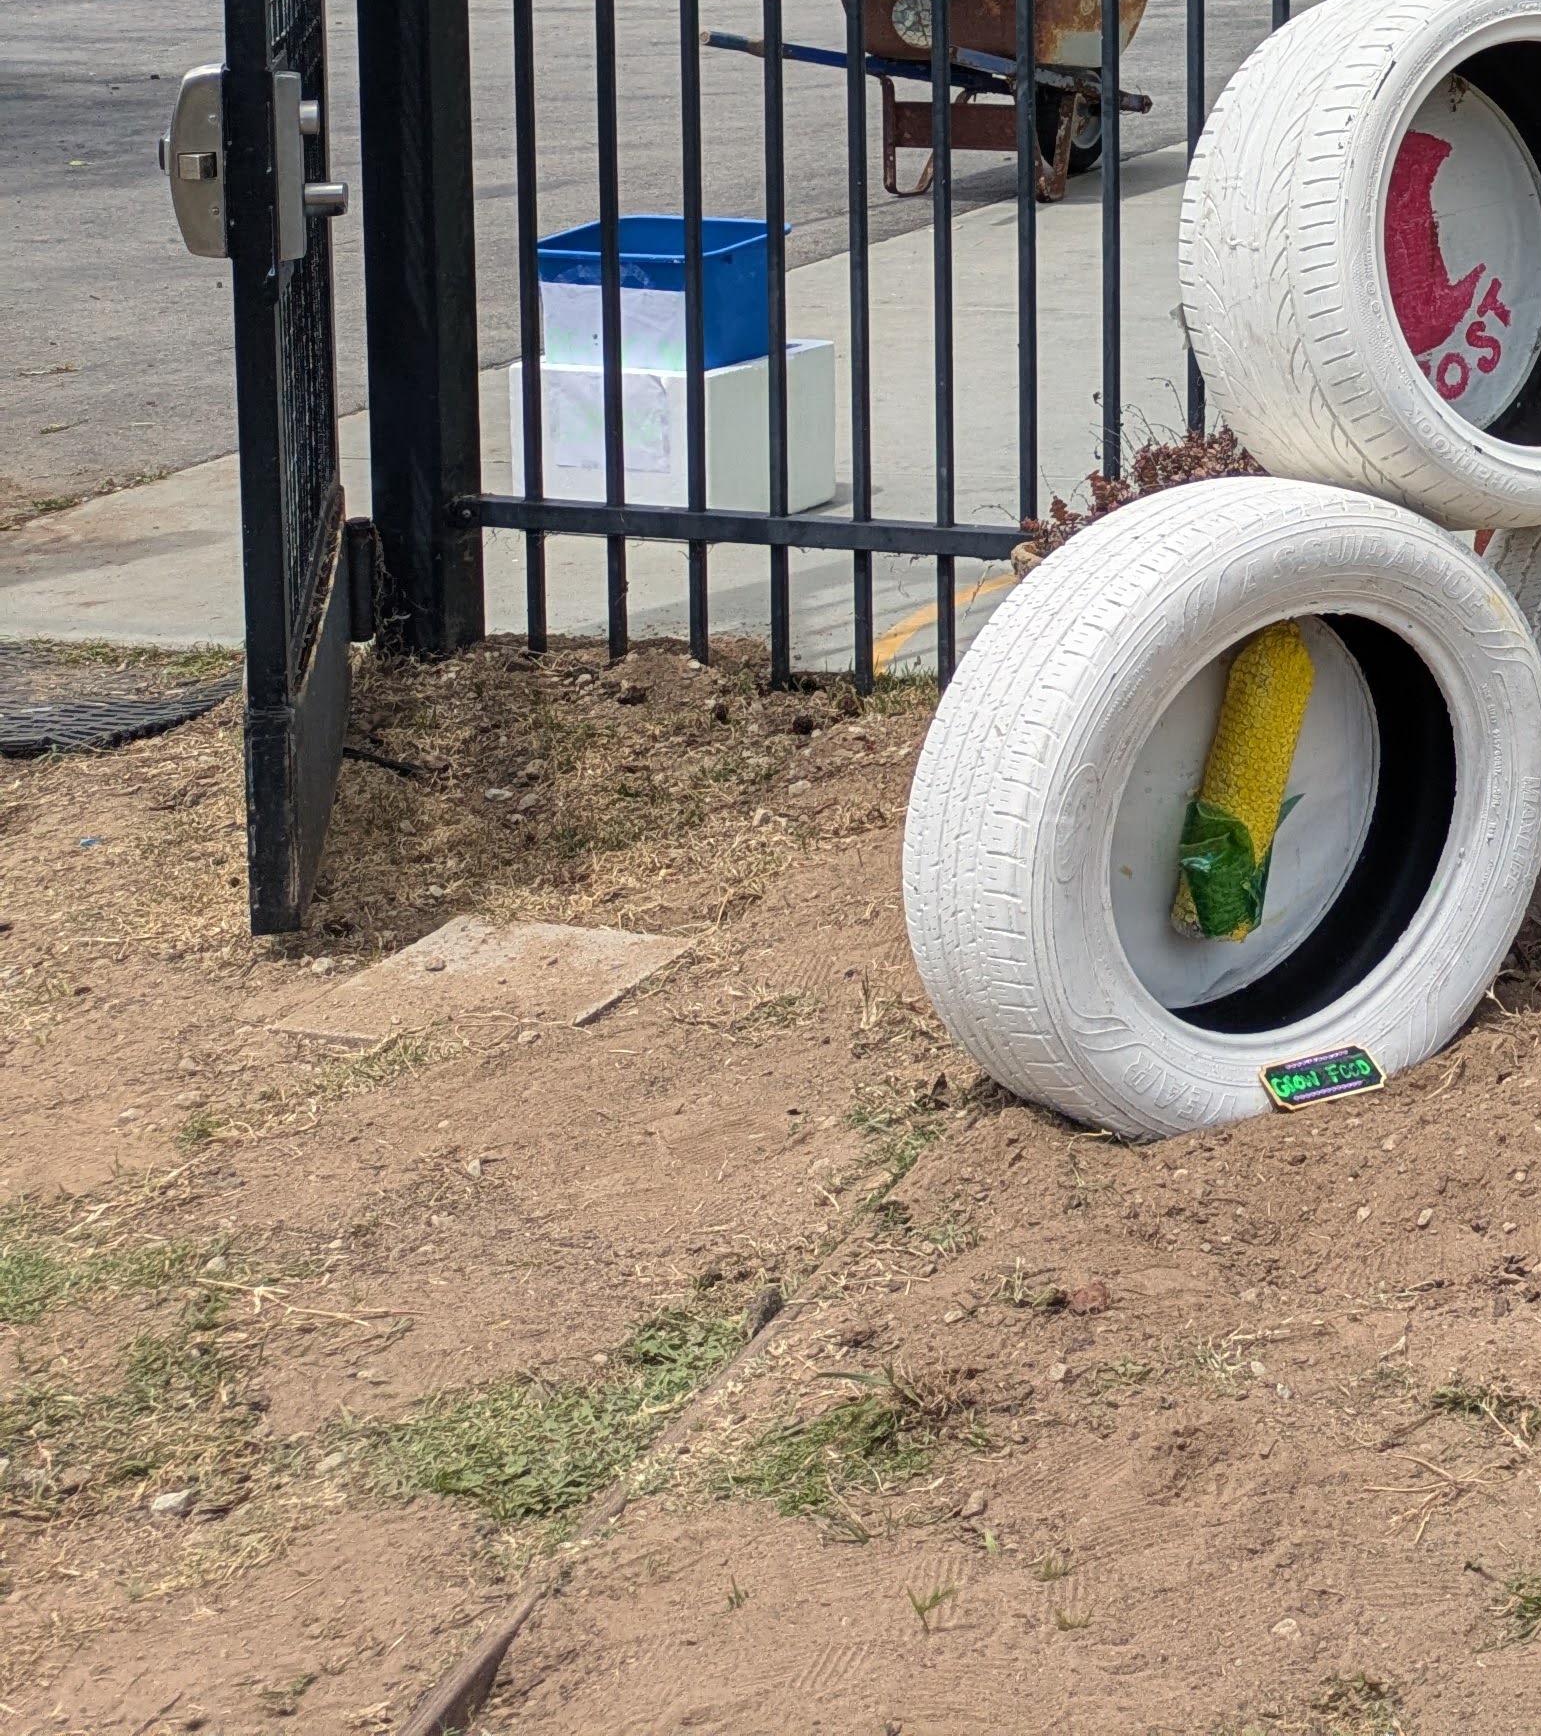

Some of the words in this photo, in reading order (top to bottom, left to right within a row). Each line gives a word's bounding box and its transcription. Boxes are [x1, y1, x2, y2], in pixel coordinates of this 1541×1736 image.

[1418, 277, 1511, 400] OST
[1239, 532, 1488, 618] ASSURANCE
[1502, 775, 1541, 894] MAXLIFE
[1324, 1059, 1371, 1083] FOOD
